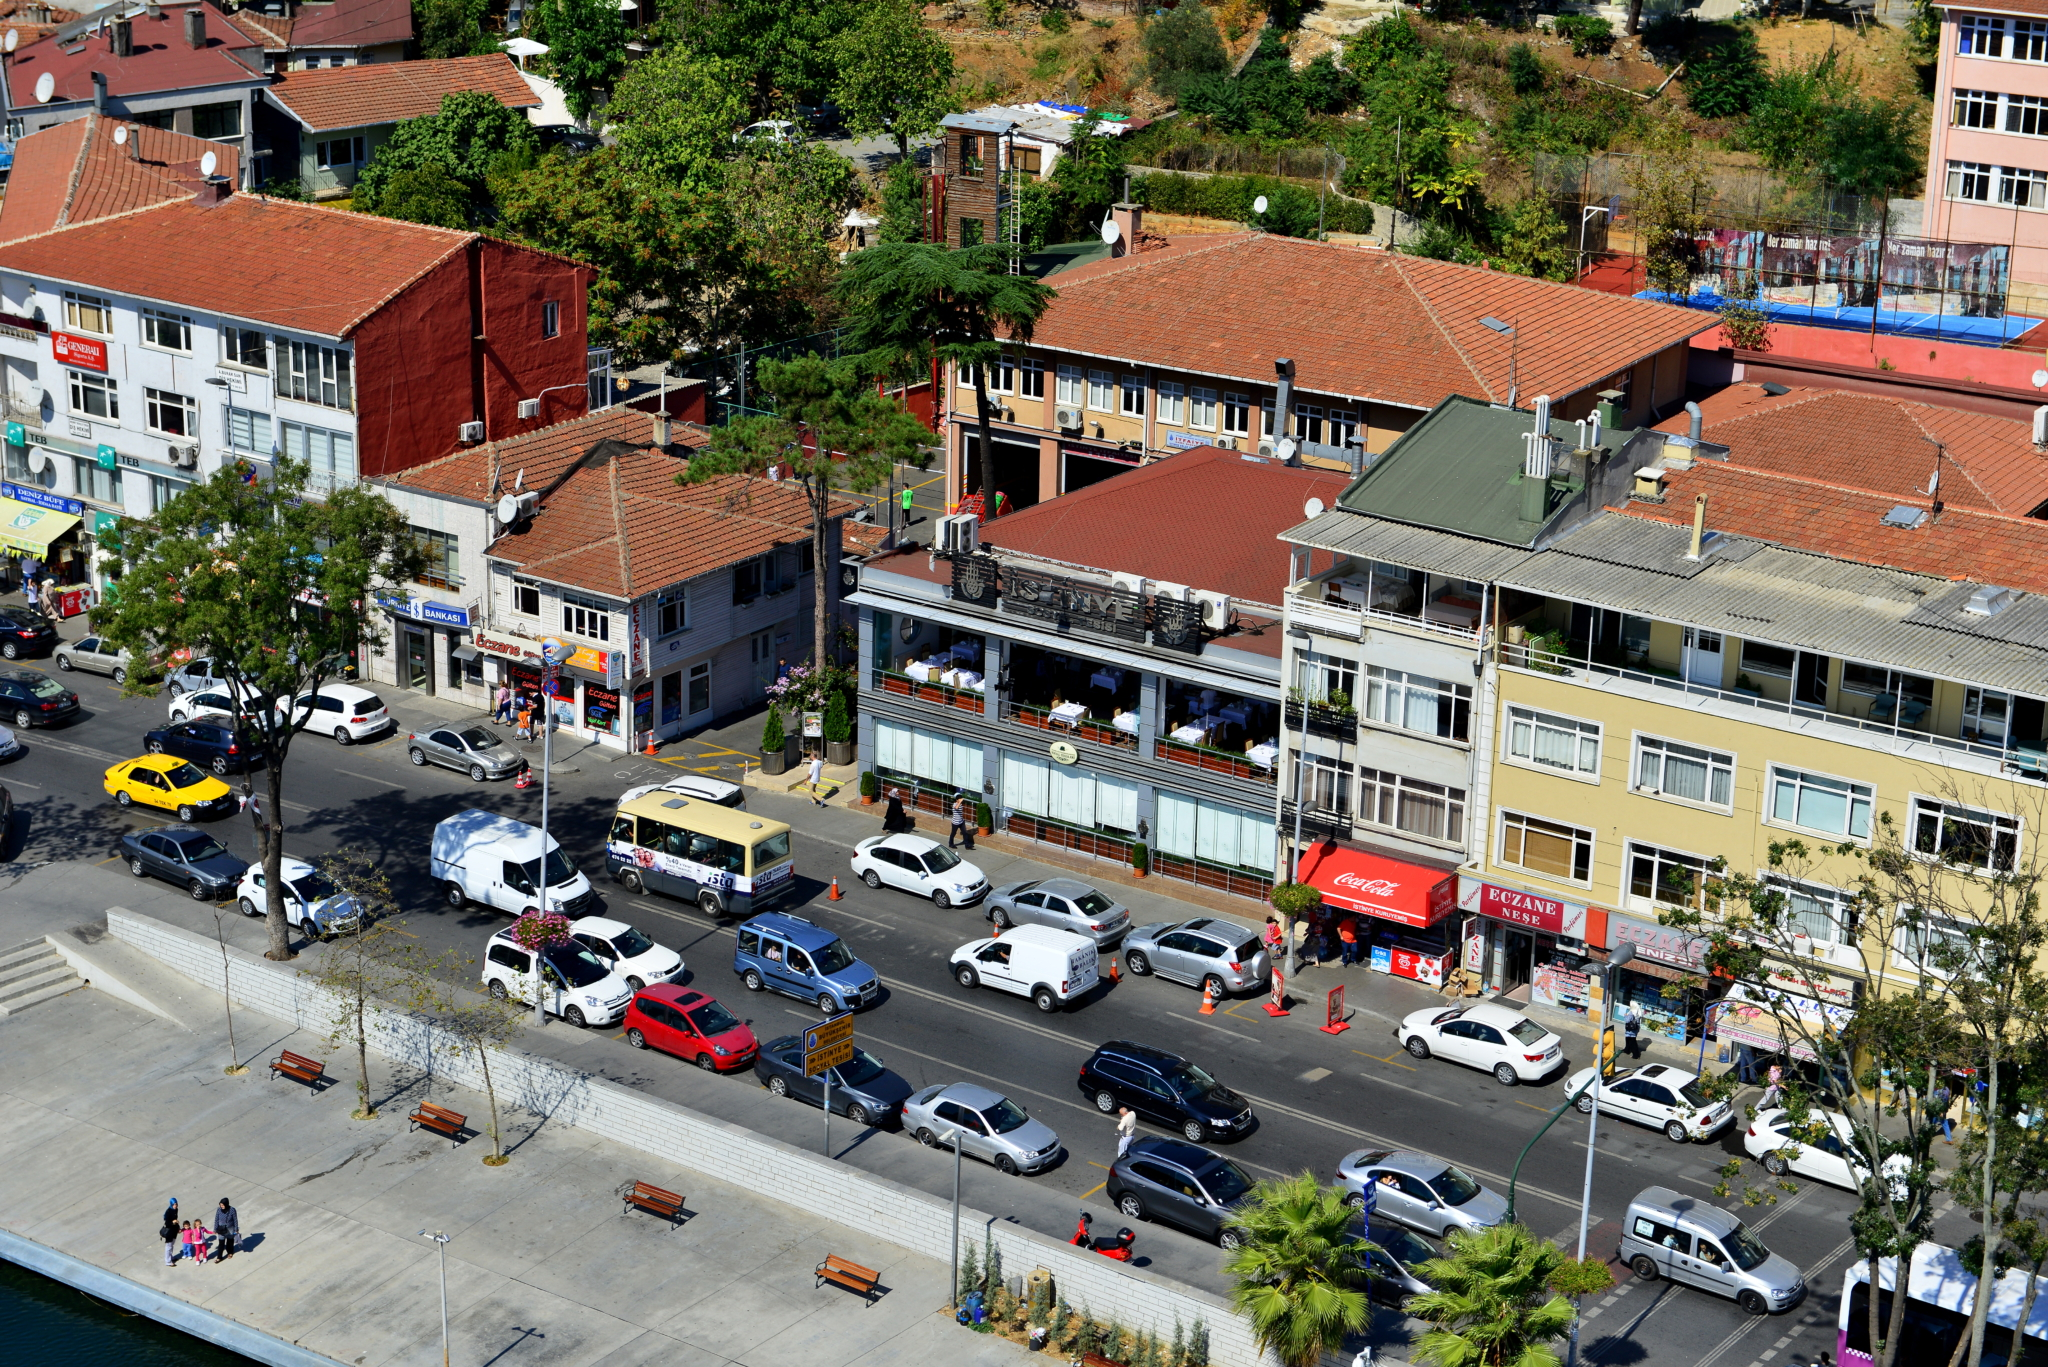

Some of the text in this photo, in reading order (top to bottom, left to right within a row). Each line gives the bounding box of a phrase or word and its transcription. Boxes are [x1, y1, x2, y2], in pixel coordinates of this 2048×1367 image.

[1767, 234, 1831, 252] Her zaman hazrız!
[1887, 241, 1954, 259] Her zaman hazırz!
[30, 433, 47, 445] TEB
[121, 455, 140, 467] TEB
[18, 488, 65, 506] DENİZ BÜFE
[1010, 570, 1134, 622] İSİNYE
[425, 609, 461, 622] BANKASI
[632, 604, 641, 661] ECZANE
[475, 634, 520, 656] Eczane
[588, 686, 618, 702] Eczane
[708, 872, 733, 889] ista
[1333, 872, 1401, 897] Coca-Cola
[1488, 887, 1557, 915] ECZANE
[1353, 902, 1408, 923] İSTİNYE KURUYEMİŞ
[1502, 907, 1540, 925] NEŞE
[1616, 921, 1704, 959] ECZANE
[809, 1051, 851, 1075] SOSYAL TESİSİ
[817, 1046, 842, 1062] İSTİNYE
